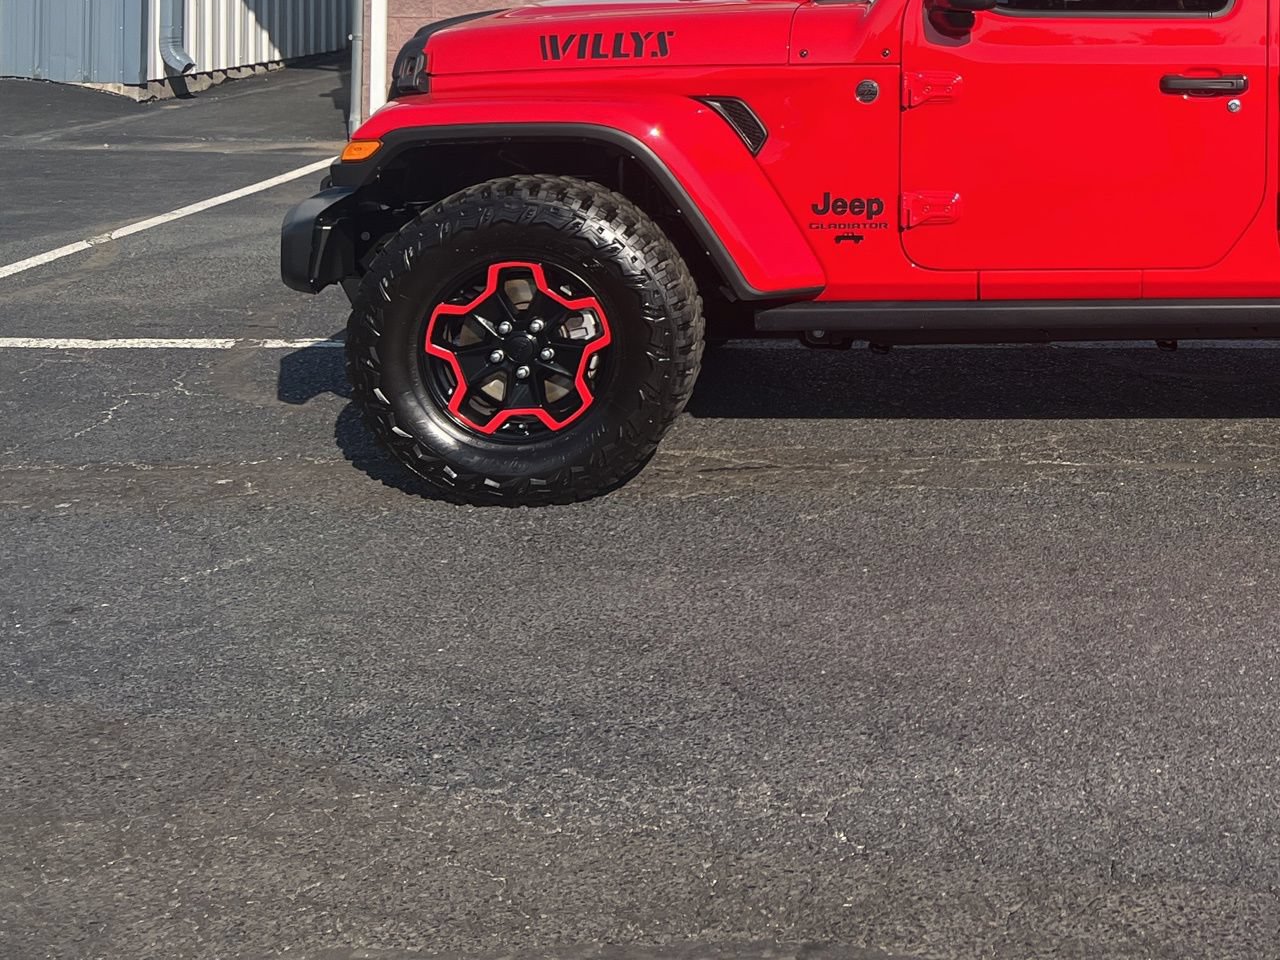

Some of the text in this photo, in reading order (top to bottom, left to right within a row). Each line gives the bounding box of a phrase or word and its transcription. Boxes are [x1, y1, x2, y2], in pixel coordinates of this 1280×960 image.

[539, 30, 676, 61] WILLYS
[811, 191, 885, 220] Jeep
[808, 222, 889, 230] GLADIATOR
